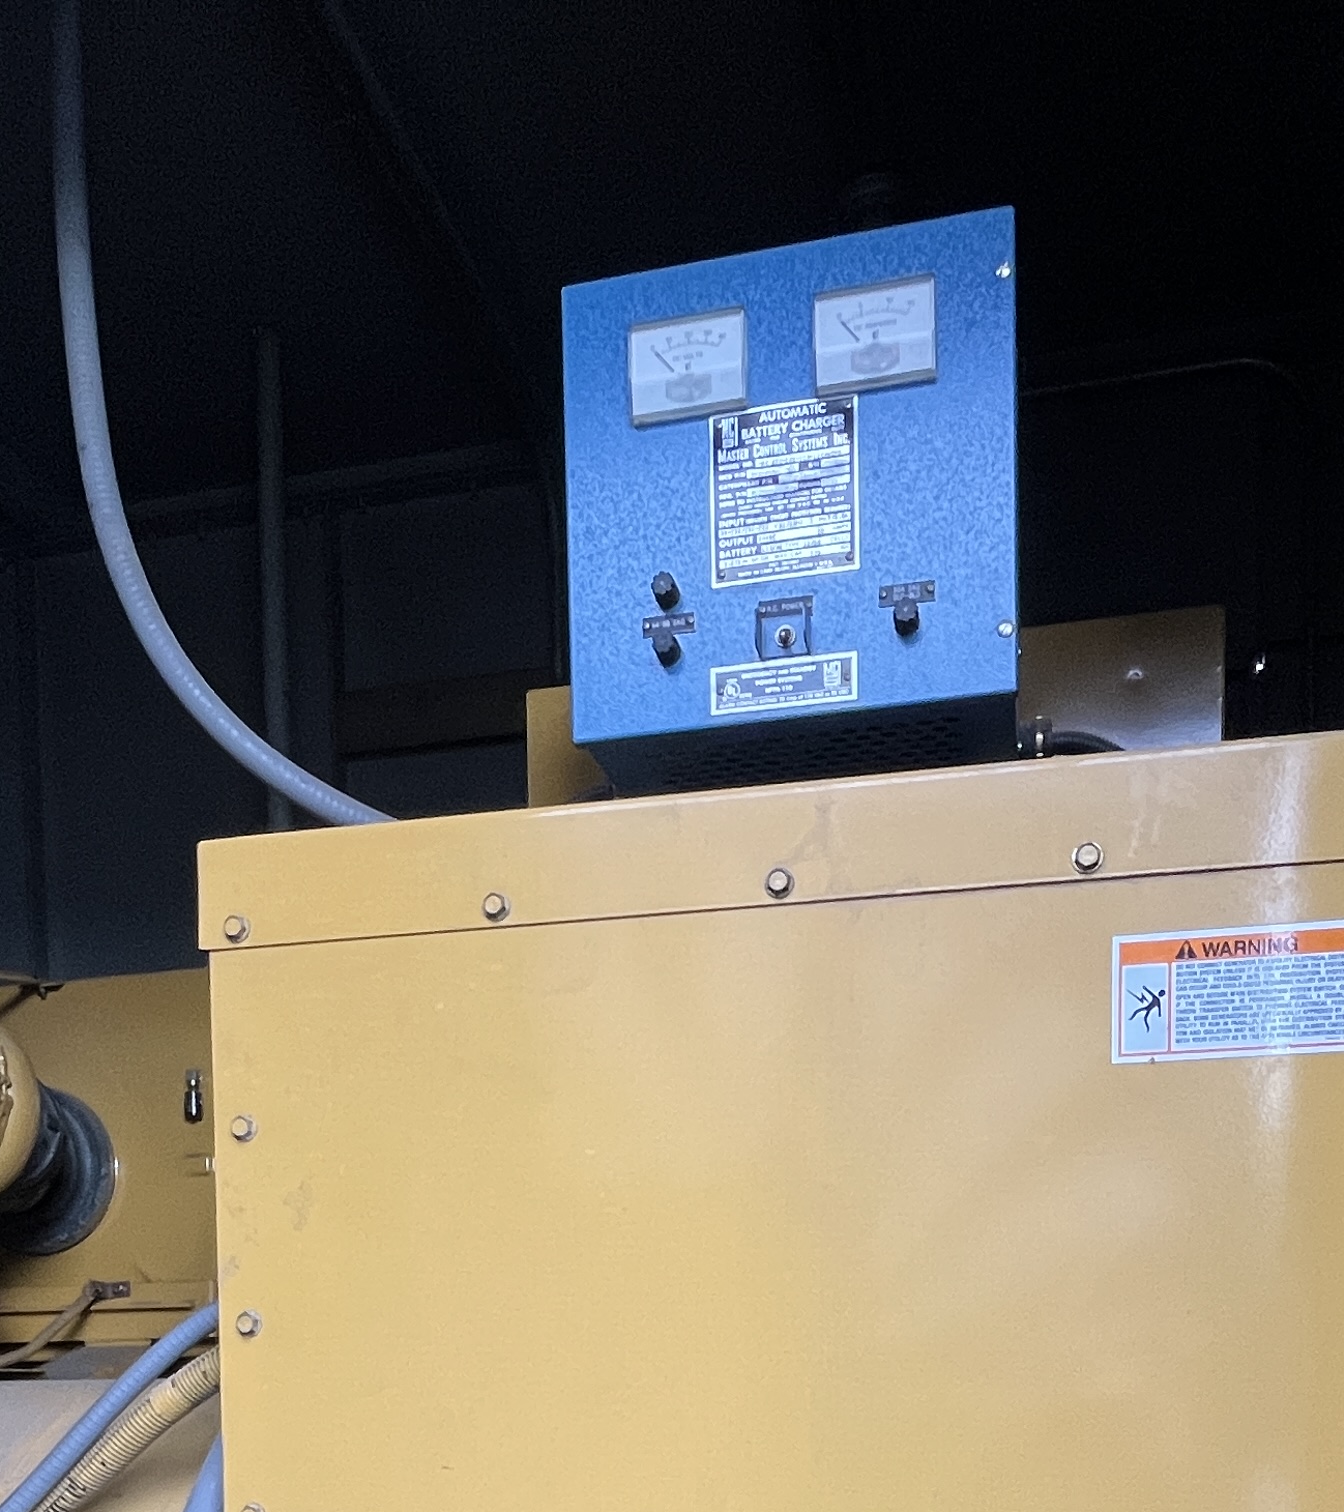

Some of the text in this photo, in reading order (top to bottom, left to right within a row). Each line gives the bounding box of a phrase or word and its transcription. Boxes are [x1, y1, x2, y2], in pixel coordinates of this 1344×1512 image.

[759, 402, 827, 423] AUTOMATIC
[741, 422, 788, 440] BATTERY
[791, 414, 845, 432] CHARGER
[718, 448, 749, 464] MASTER
[753, 442, 787, 458] CONTROL
[792, 435, 828, 452] SYSTEMS
[719, 518, 744, 528] INPUT
[719, 536, 754, 548] OUTPUT
[719, 546, 758, 559] BATTERY
[1202, 937, 1299, 957] WARNING
